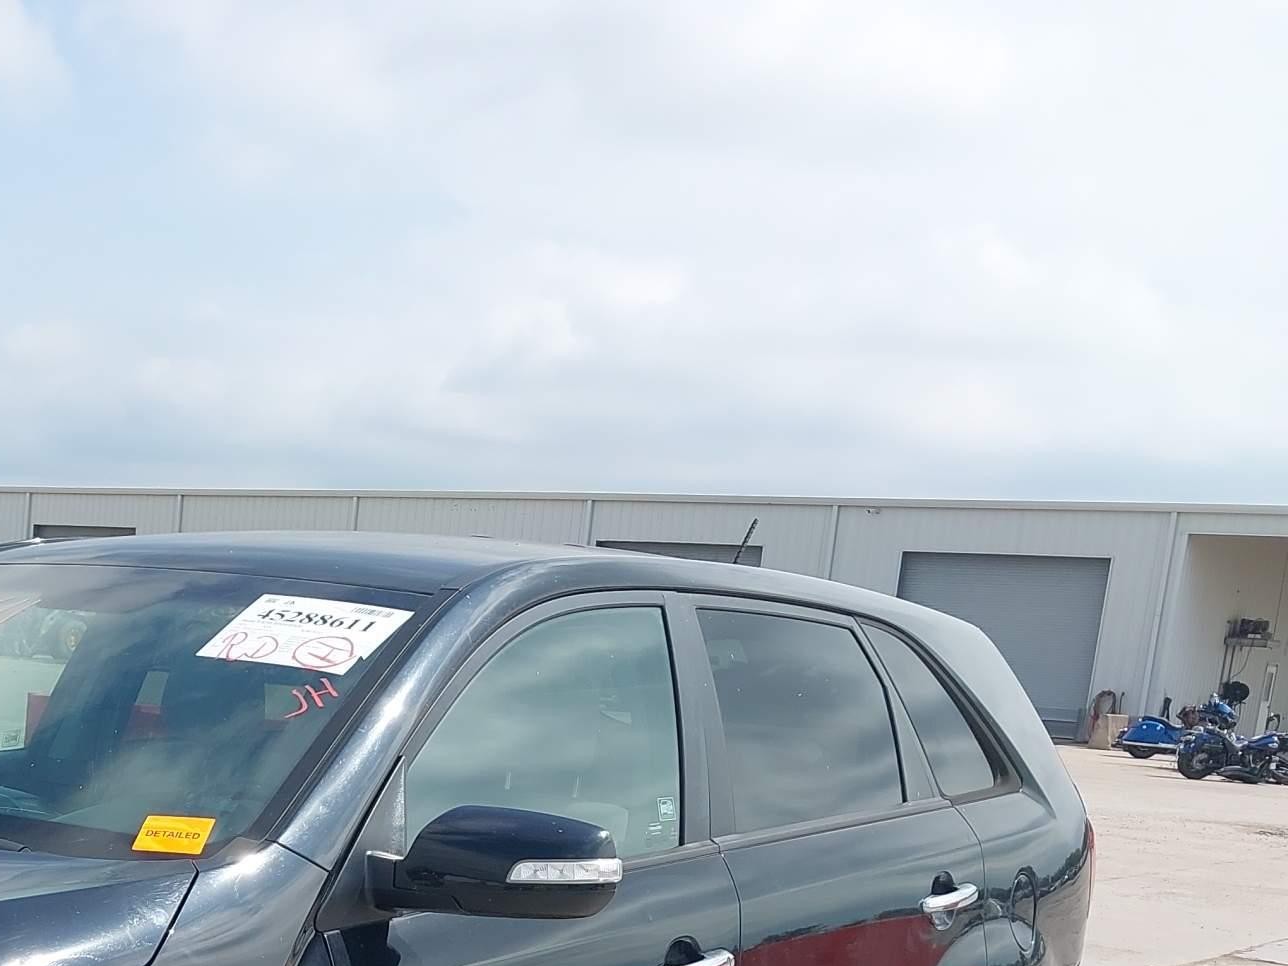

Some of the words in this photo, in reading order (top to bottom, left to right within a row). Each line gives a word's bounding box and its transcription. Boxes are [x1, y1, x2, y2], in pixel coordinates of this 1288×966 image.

[257, 608, 377, 633] 45288611
[284, 677, 340, 719] JH
[145, 829, 201, 840] DETAILED
